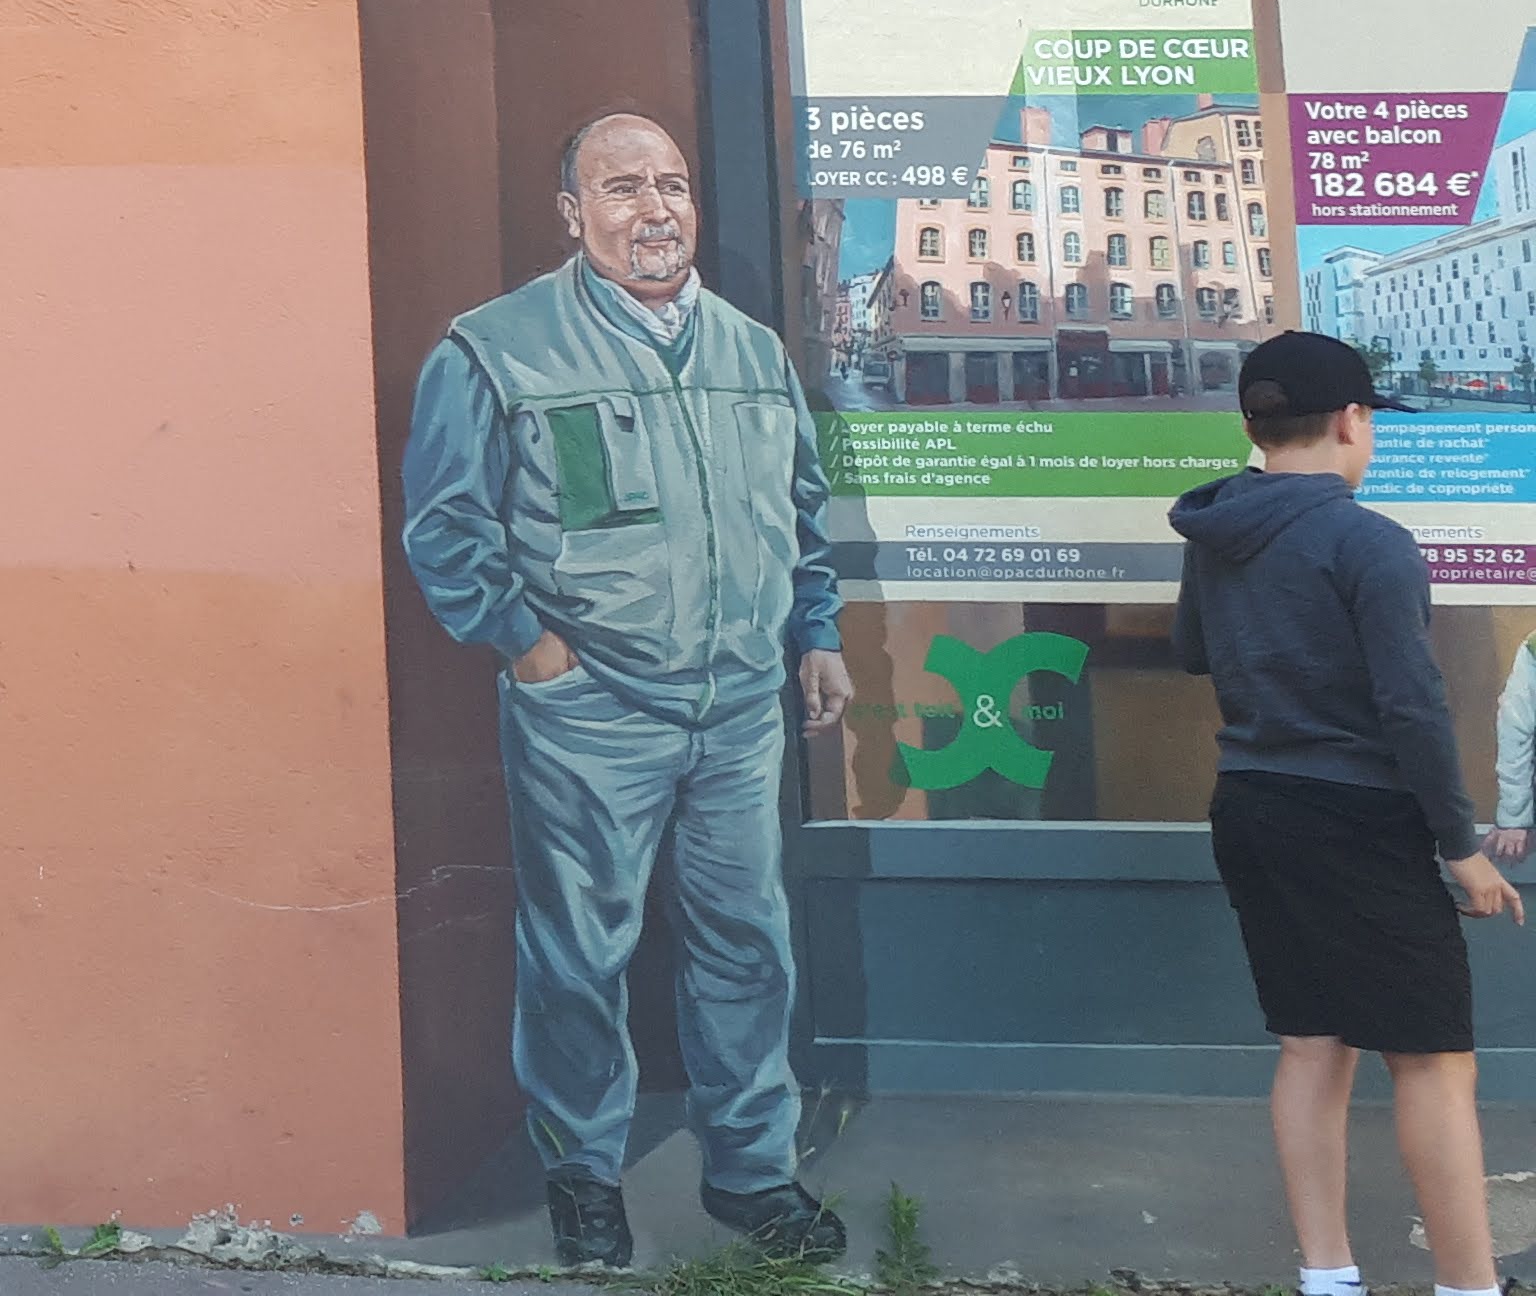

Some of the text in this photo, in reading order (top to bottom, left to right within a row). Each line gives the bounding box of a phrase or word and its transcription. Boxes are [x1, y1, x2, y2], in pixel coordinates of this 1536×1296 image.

[1034, 38, 1249, 60] COUP DE CŒUR
[1027, 64, 1195, 86] VIEUX LYON
[806, 105, 924, 135] 3 pièces
[1305, 101, 1468, 122] Votre 4 pièces
[1307, 127, 1441, 144] avec balcon
[808, 140, 832, 159] de
[839, 141, 866, 159] 76
[1309, 152, 1335, 169] 78
[865, 166, 969, 186] CC 498 €
[1311, 173, 1438, 197] 182 684
[1312, 203, 1458, 216] hors stationnement
[888, 420, 1053, 435] payable à terme échu
[842, 438, 957, 450] Possibilité APL
[843, 454, 888, 470] Dépôt
[892, 455, 911, 468] de
[916, 455, 976, 470] garantie
[980, 455, 1012, 470] égal
[1016, 455, 1026, 468] à
[1039, 455, 1074, 468] mois
[1079, 456, 1097, 468] de
[1102, 455, 1139, 470] loyer
[1143, 456, 1175, 468] hors
[1179, 456, 1238, 471] charges
[844, 472, 991, 486] Sans frais d'agence
[905, 525, 1039, 540] Renseignements
[906, 548, 1080, 562] Tél. 04 72 69 01 69
[1444, 549, 1526, 563] 95 52 62
